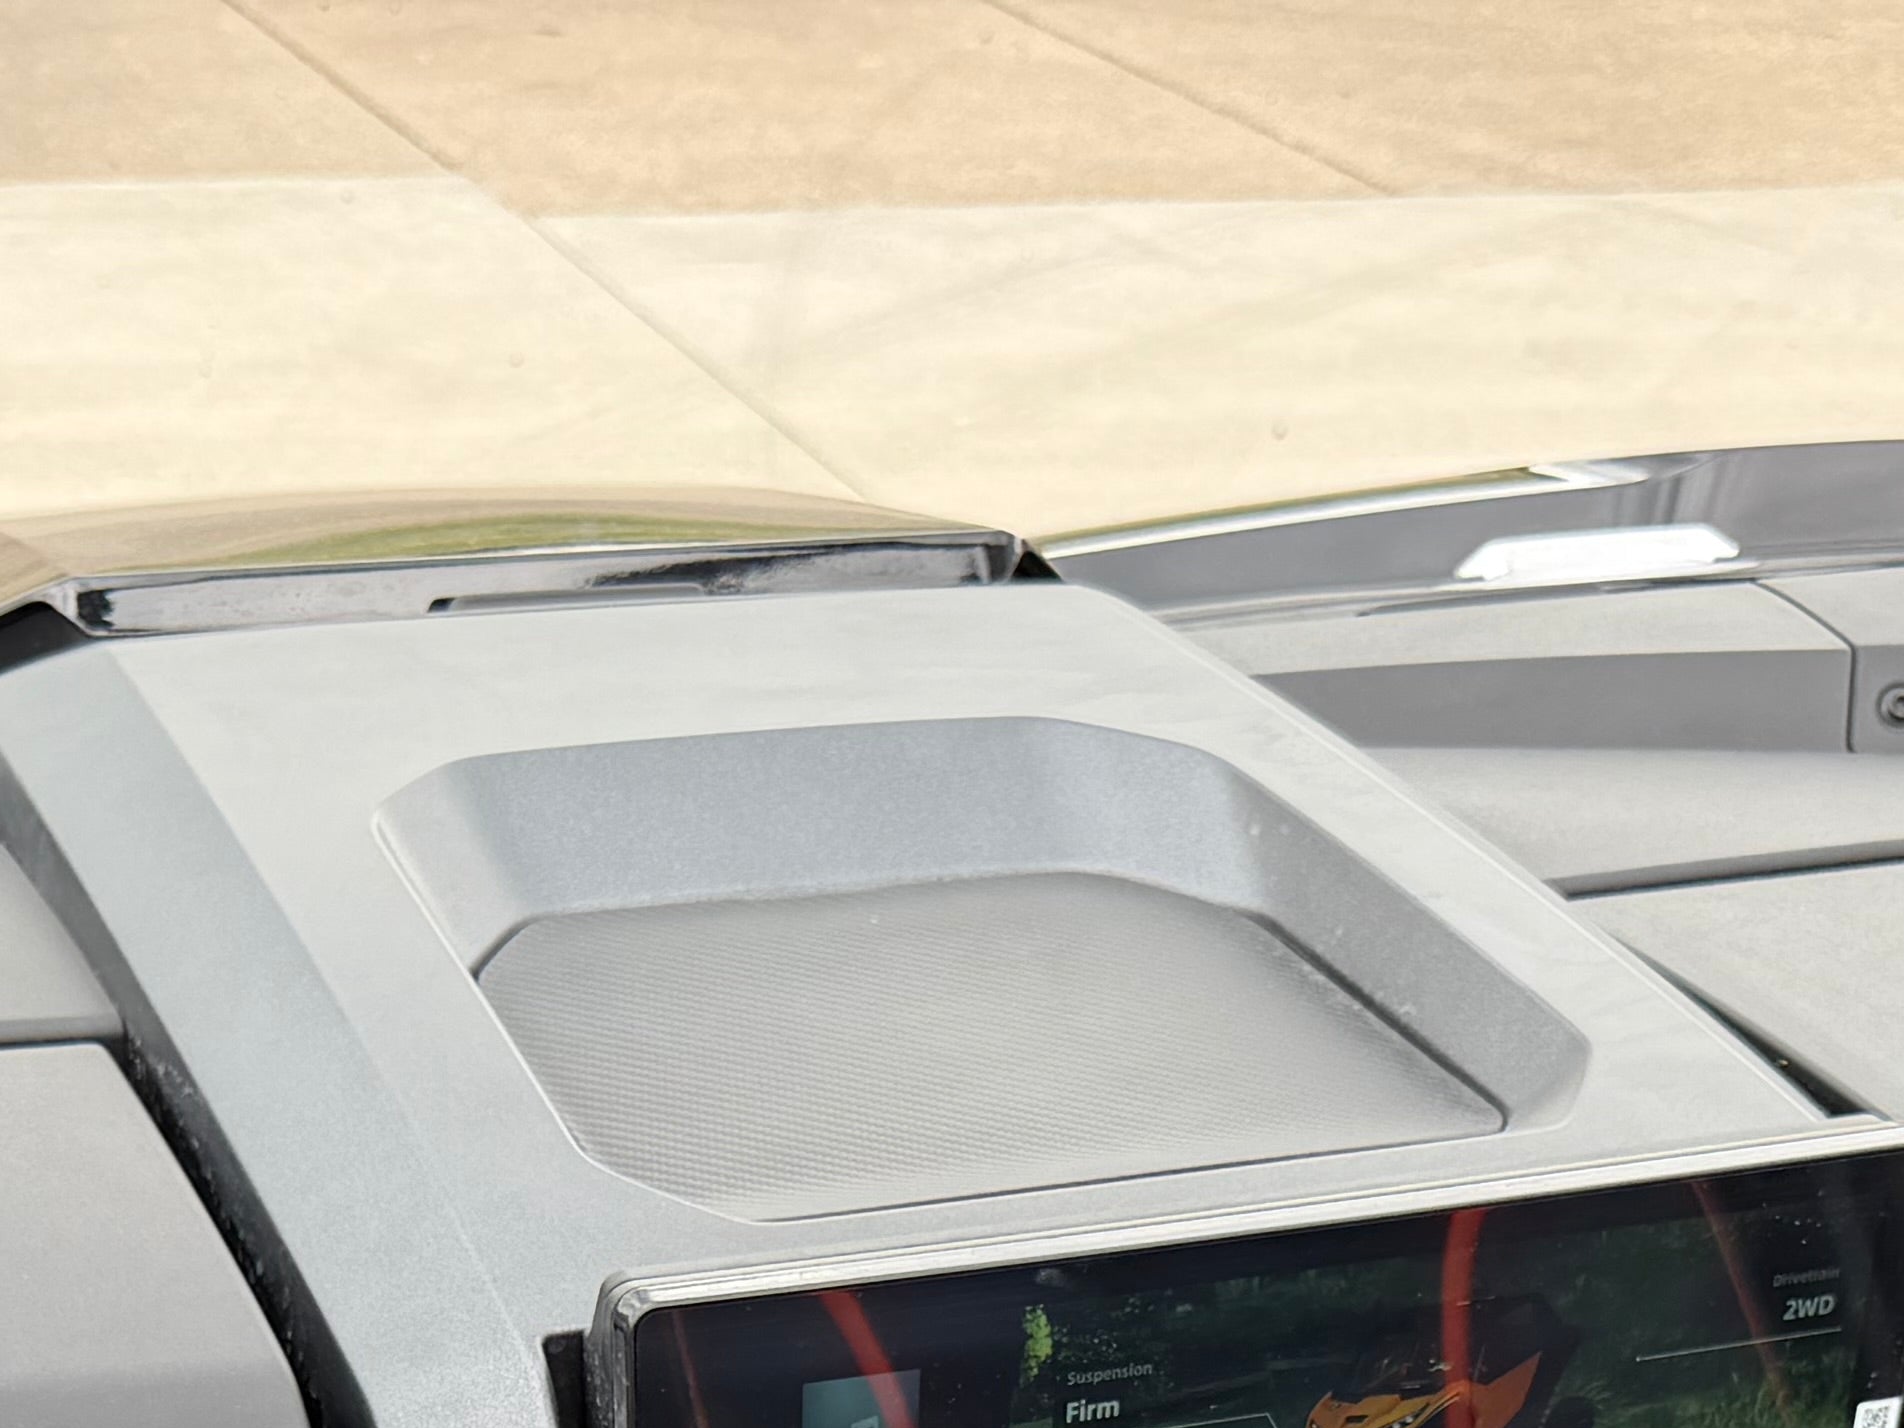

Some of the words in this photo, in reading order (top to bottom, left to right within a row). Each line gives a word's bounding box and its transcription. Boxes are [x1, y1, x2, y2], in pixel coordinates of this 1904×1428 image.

[1782, 1293, 1836, 1321] 2WD
[1067, 1361, 1153, 1386] Suspension
[1065, 1397, 1120, 1424] Firm
